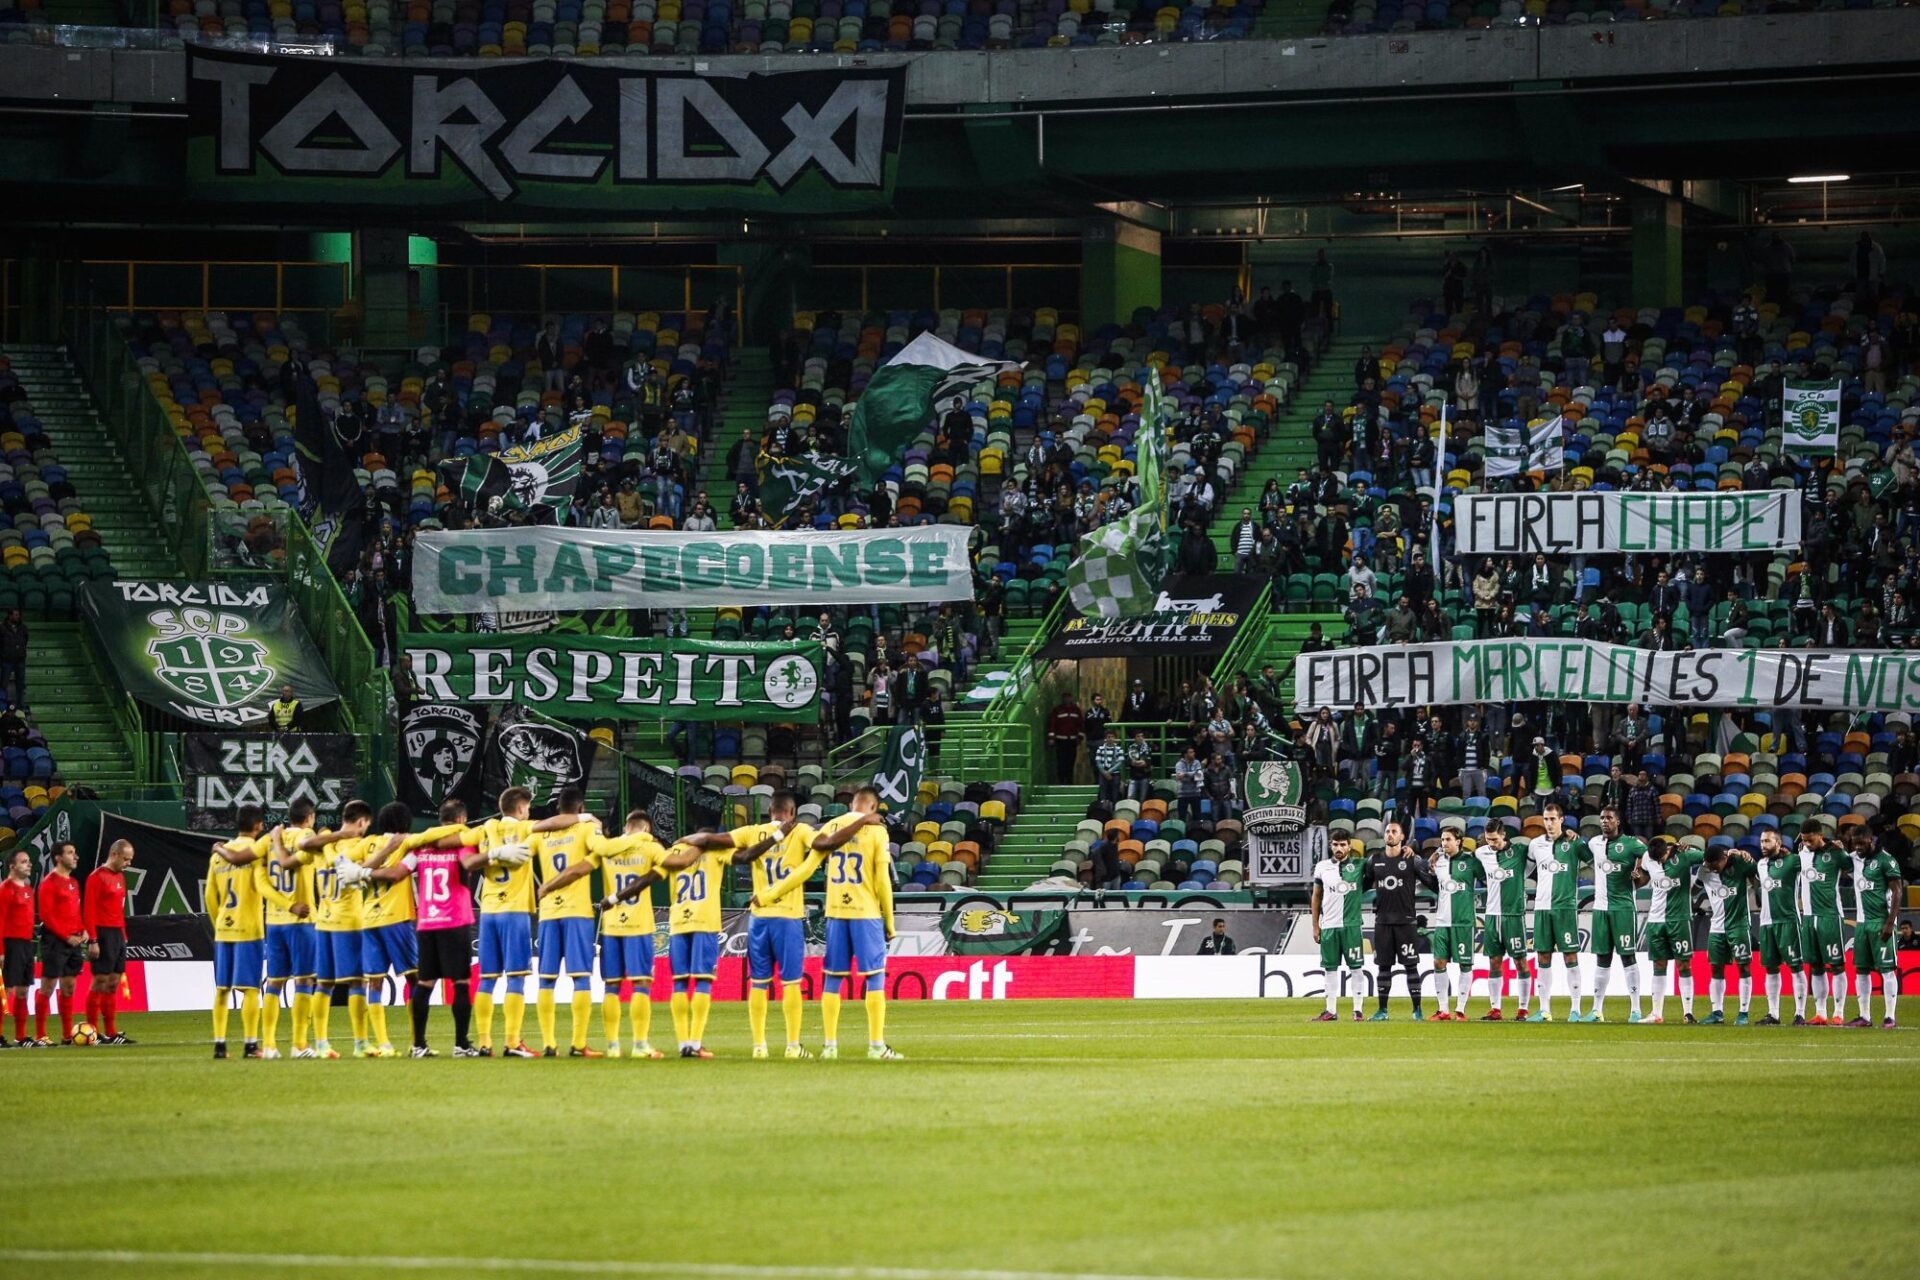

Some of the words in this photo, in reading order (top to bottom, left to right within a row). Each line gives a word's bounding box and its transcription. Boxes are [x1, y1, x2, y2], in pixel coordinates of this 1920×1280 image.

[192, 56, 889, 200] TORCIDA
[1799, 391, 1825, 400] SCP
[1795, 402, 1826, 413] SPORTING
[1471, 494, 1604, 555] FORÇA
[438, 540, 949, 597] CHAPECOENSE
[112, 581, 270, 607] TORCIDA
[148, 606, 247, 636] SCP
[1065, 636, 1134, 646] DIRECTIVO
[1136, 635, 1188, 643] ULTRAS
[1189, 634, 1213, 642] XXI
[1308, 650, 1435, 708] FORÇA
[1736, 648, 1758, 705] 1
[1773, 652, 1831, 706] DE
[168, 699, 280, 727] VERD
[412, 706, 473, 723] TORCIDA
[1250, 823, 1299, 834] SPORTING
[1260, 841, 1300, 854] ULTRAS
[831, 851, 863, 885] 33
[1262, 857, 1299, 873] XXI
[1541, 859, 1567, 874] NOS
[1488, 867, 1513, 882] NOS
[424, 868, 450, 902] 13
[676, 870, 706, 904] 20
[1329, 879, 1356, 895] NOS
[1378, 875, 1403, 890] NOS
[1653, 876, 1680, 891] NOS
[1711, 884, 1737, 899] NOS
[1510, 937, 1522, 949] 15
[1564, 932, 1571, 944] 8
[1619, 935, 1631, 947] 19
[165, 944, 188, 957] TV
[1349, 947, 1361, 961] 47
[1401, 943, 1415, 956] 34
[1458, 943, 1466, 955] 3
[1675, 940, 1689, 954] 99
[1734, 944, 1747, 957] 22
[1826, 943, 1839, 957] 16
[1880, 947, 1888, 959] 7
[932, 959, 1014, 1000] ctt
